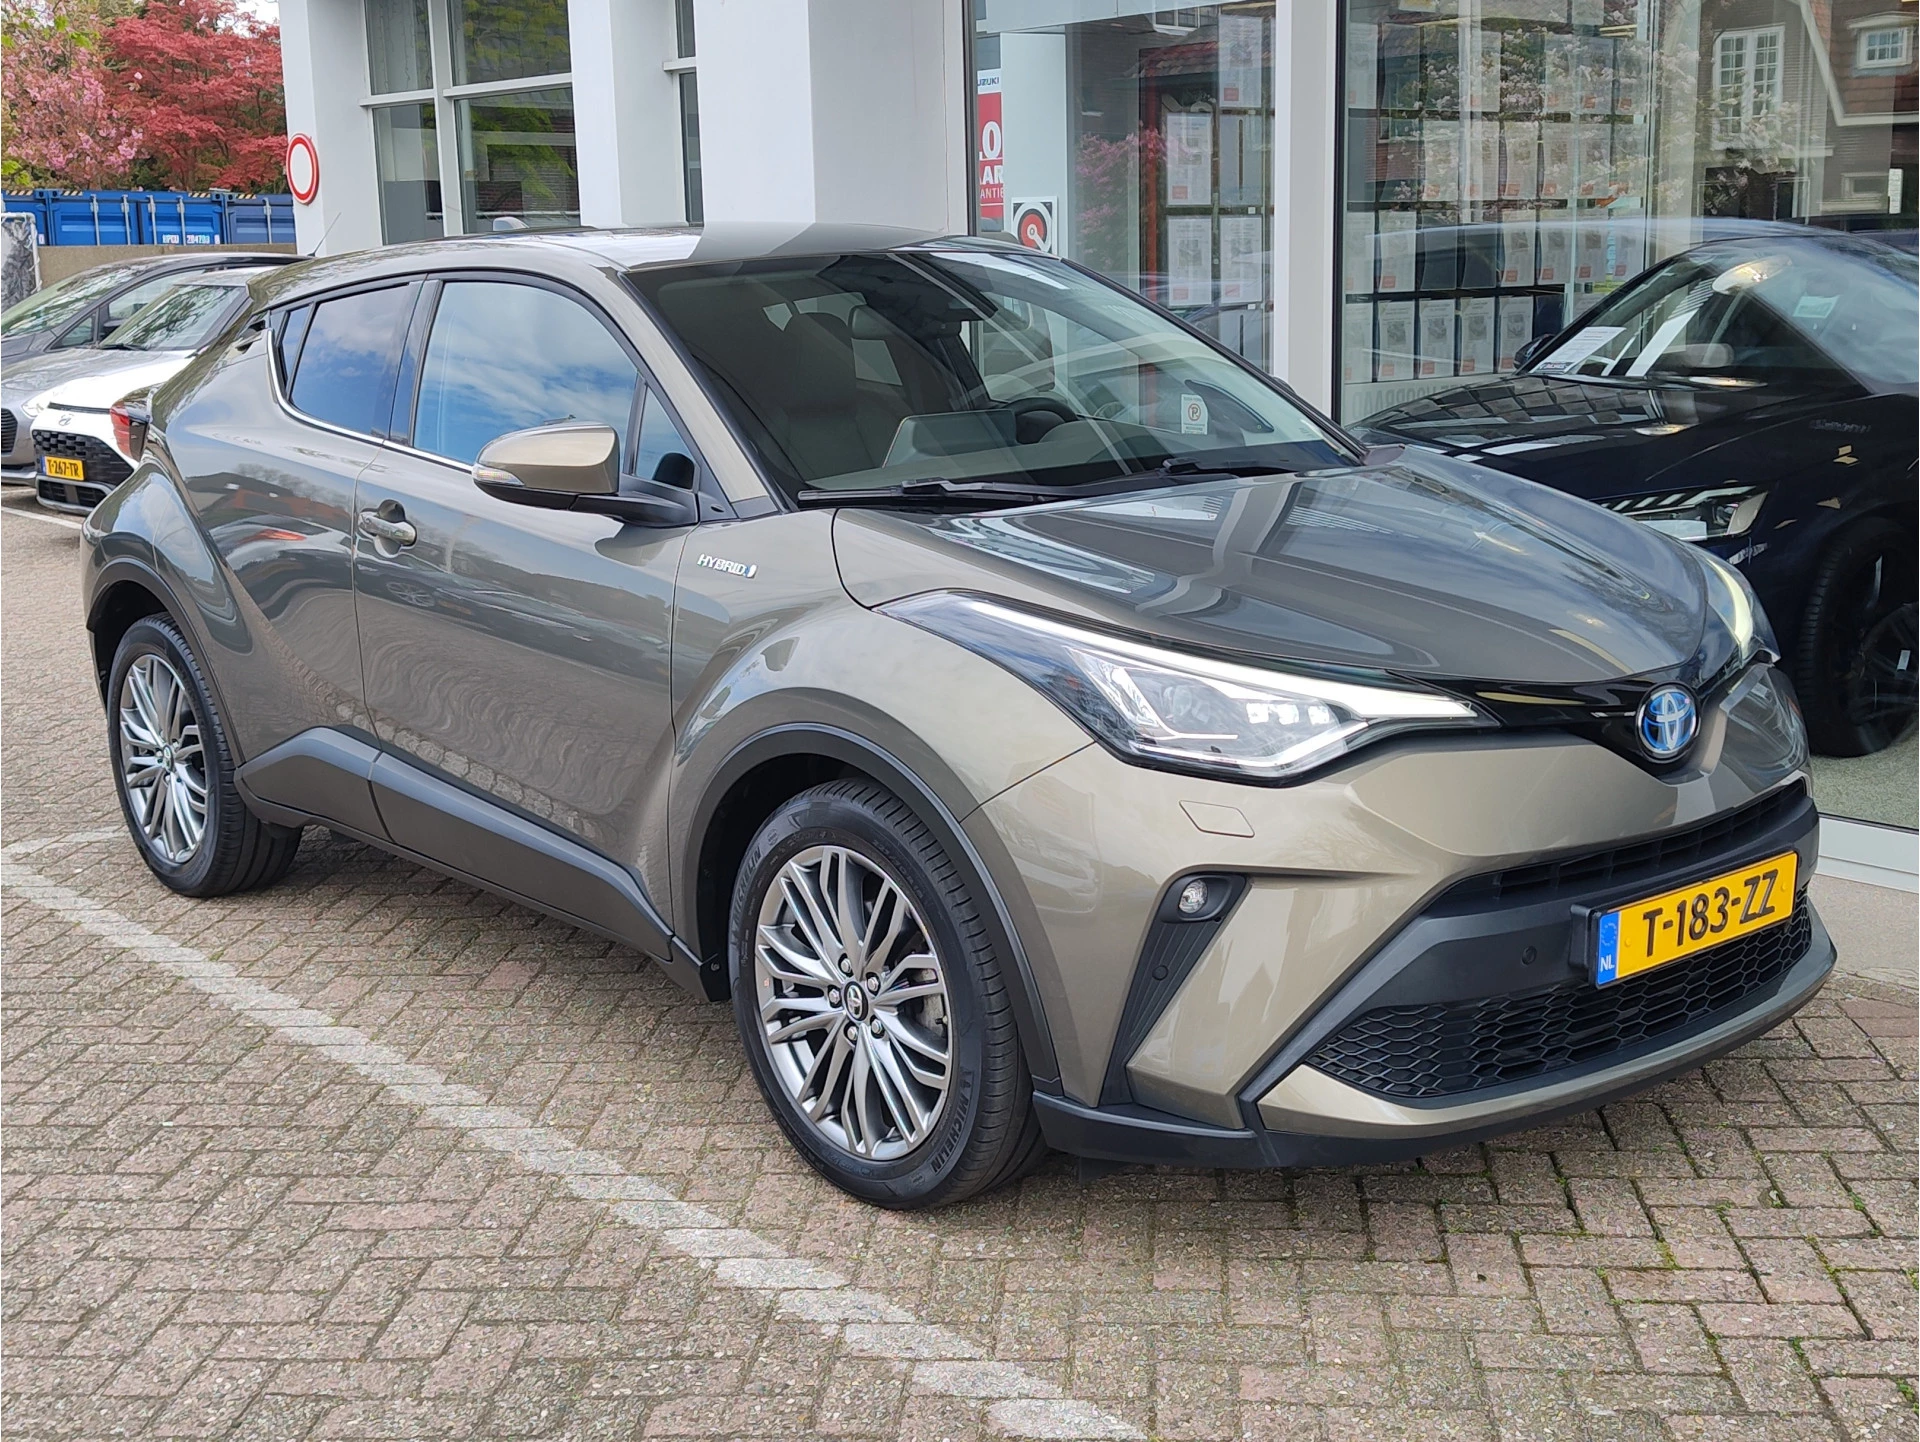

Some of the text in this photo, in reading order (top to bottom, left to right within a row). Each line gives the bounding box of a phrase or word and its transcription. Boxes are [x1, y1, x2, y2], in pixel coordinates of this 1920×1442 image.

[46, 458, 81, 478] T-267-TR
[697, 553, 747, 576] HYBRID
[1642, 868, 1779, 958] T-183-ZZ
[1599, 954, 1615, 973] NL
[930, 1092, 970, 1174] MICHELIN
